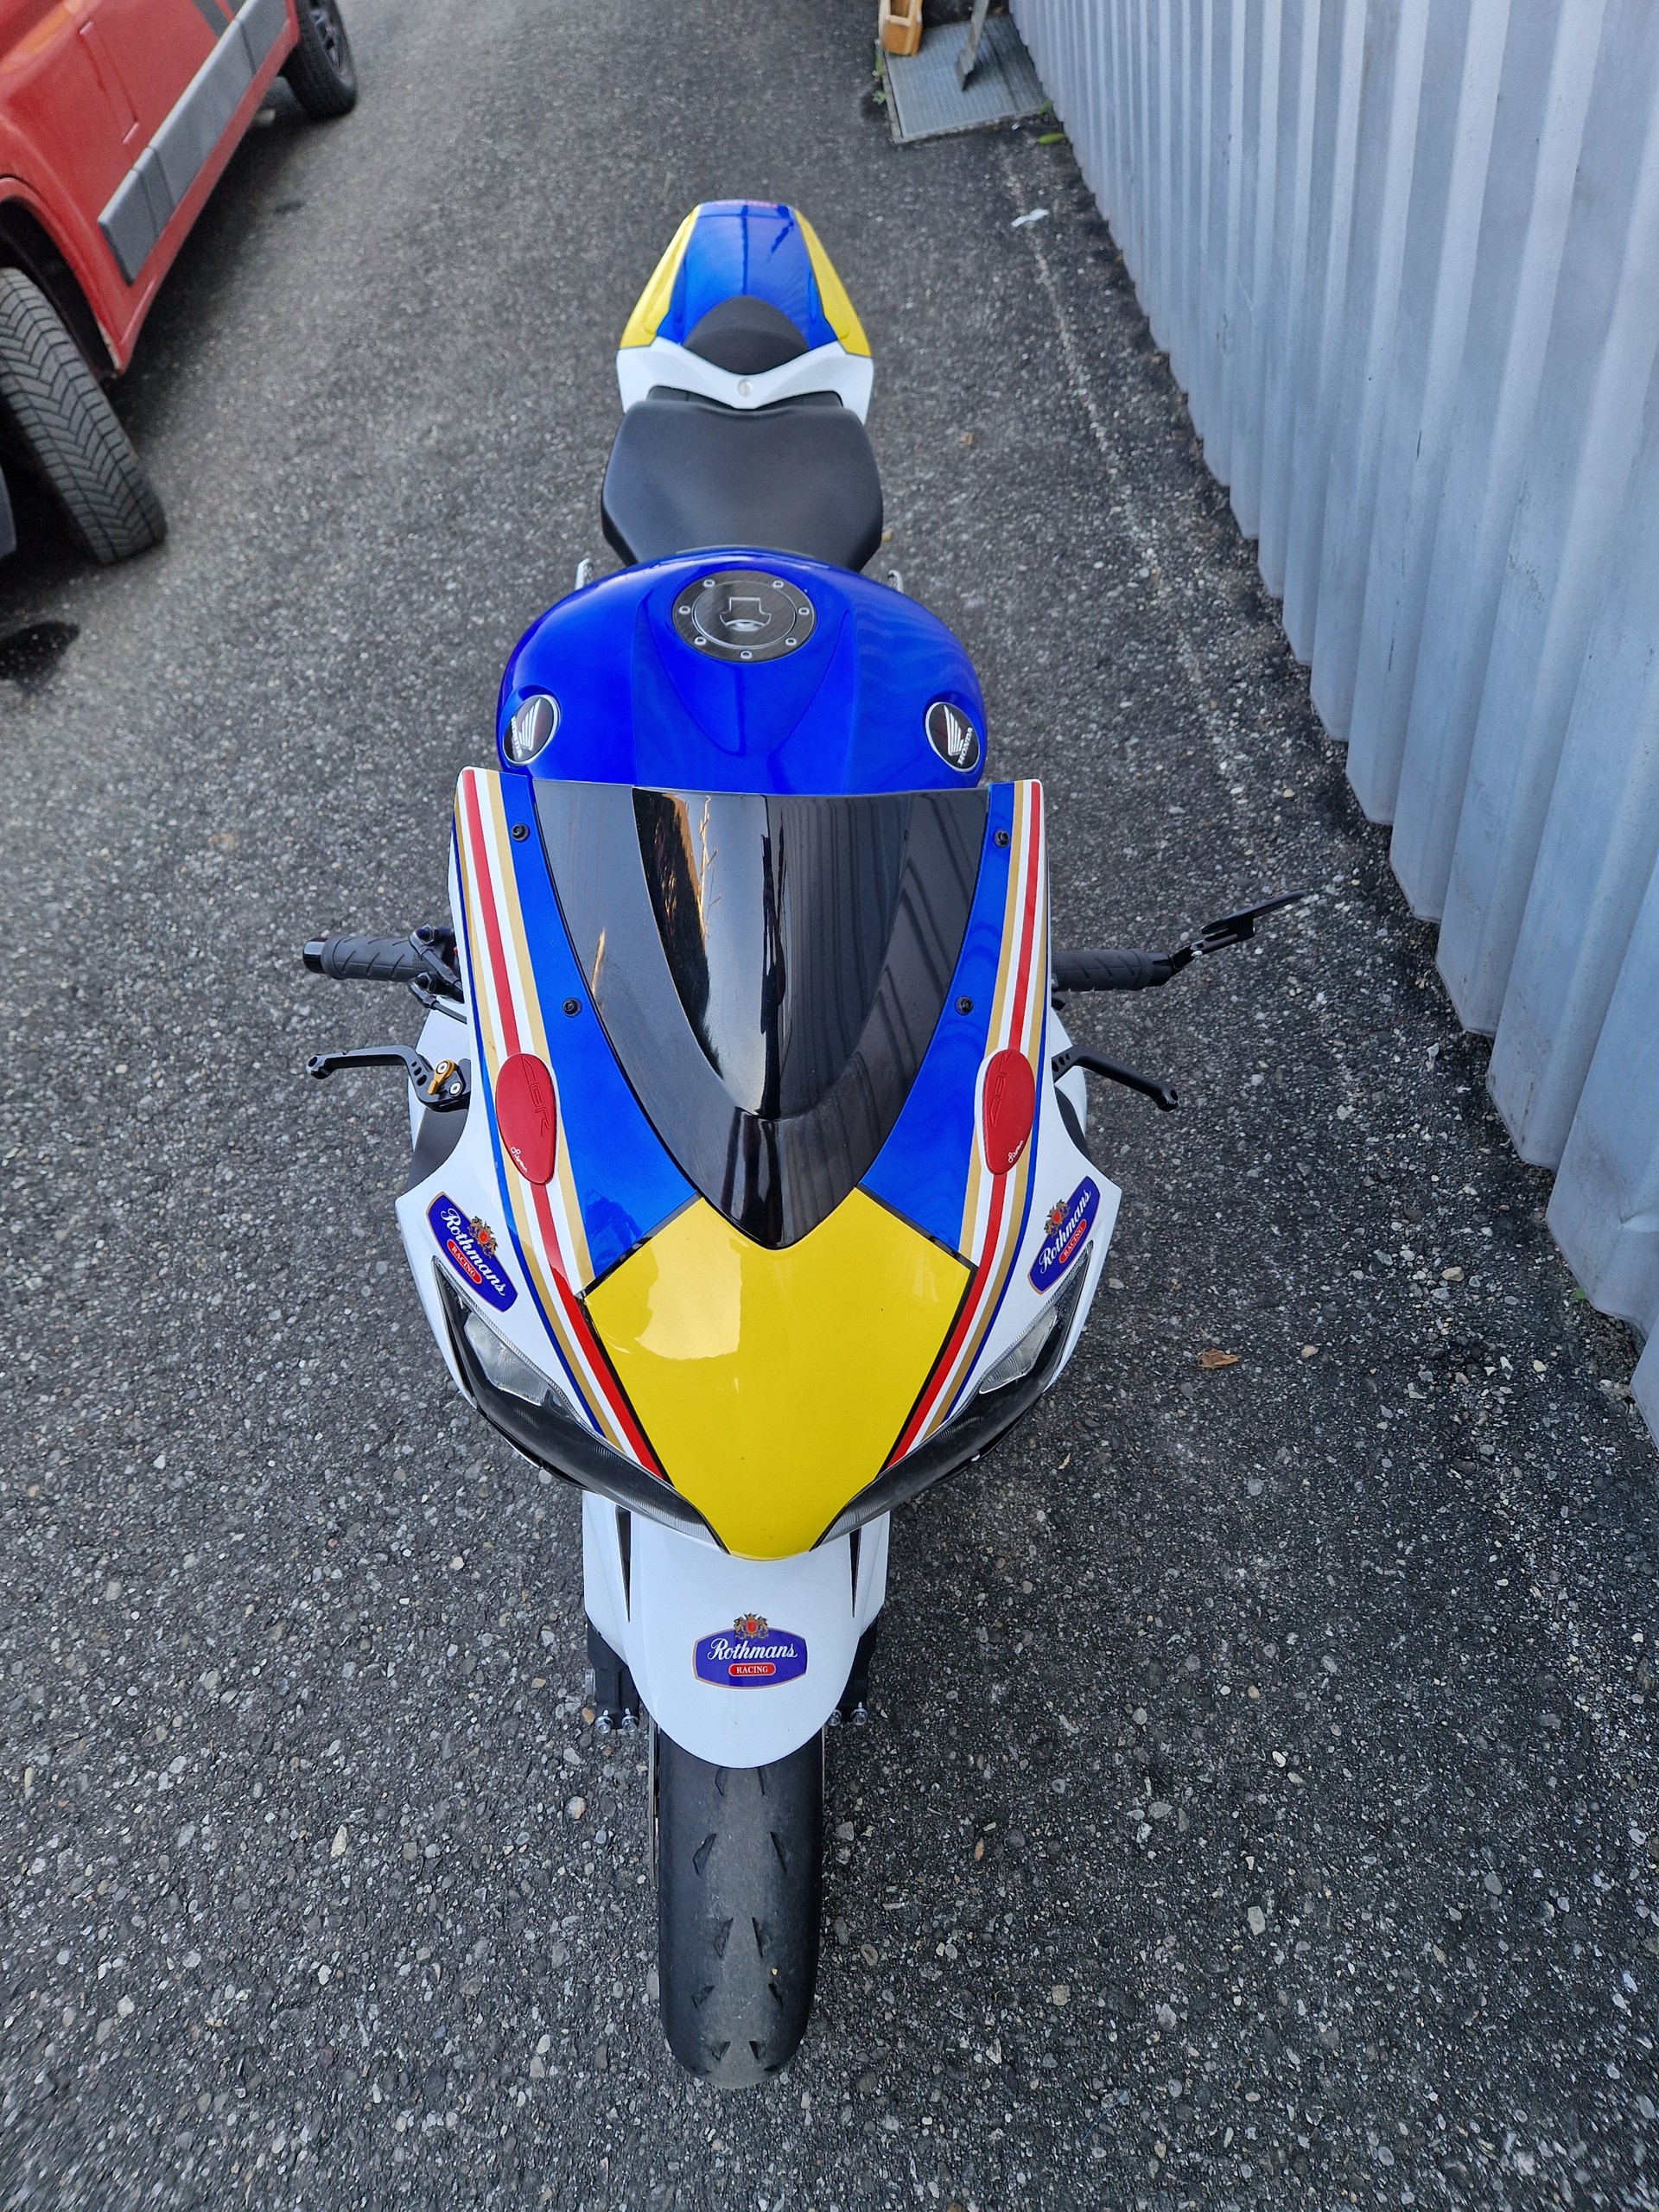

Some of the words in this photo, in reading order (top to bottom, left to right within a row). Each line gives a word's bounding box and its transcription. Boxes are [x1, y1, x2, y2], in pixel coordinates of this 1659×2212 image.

[957, 727, 973, 766] HONDA
[521, 1054, 552, 1137] CBR
[1039, 1189, 1091, 1274] Rothmans
[1063, 1226, 1083, 1258] RACING
[441, 1207, 505, 1296] Rothmans
[451, 1245, 476, 1278] RACING
[706, 1637, 798, 1661] Rothmans
[735, 1665, 768, 1674] RACING
